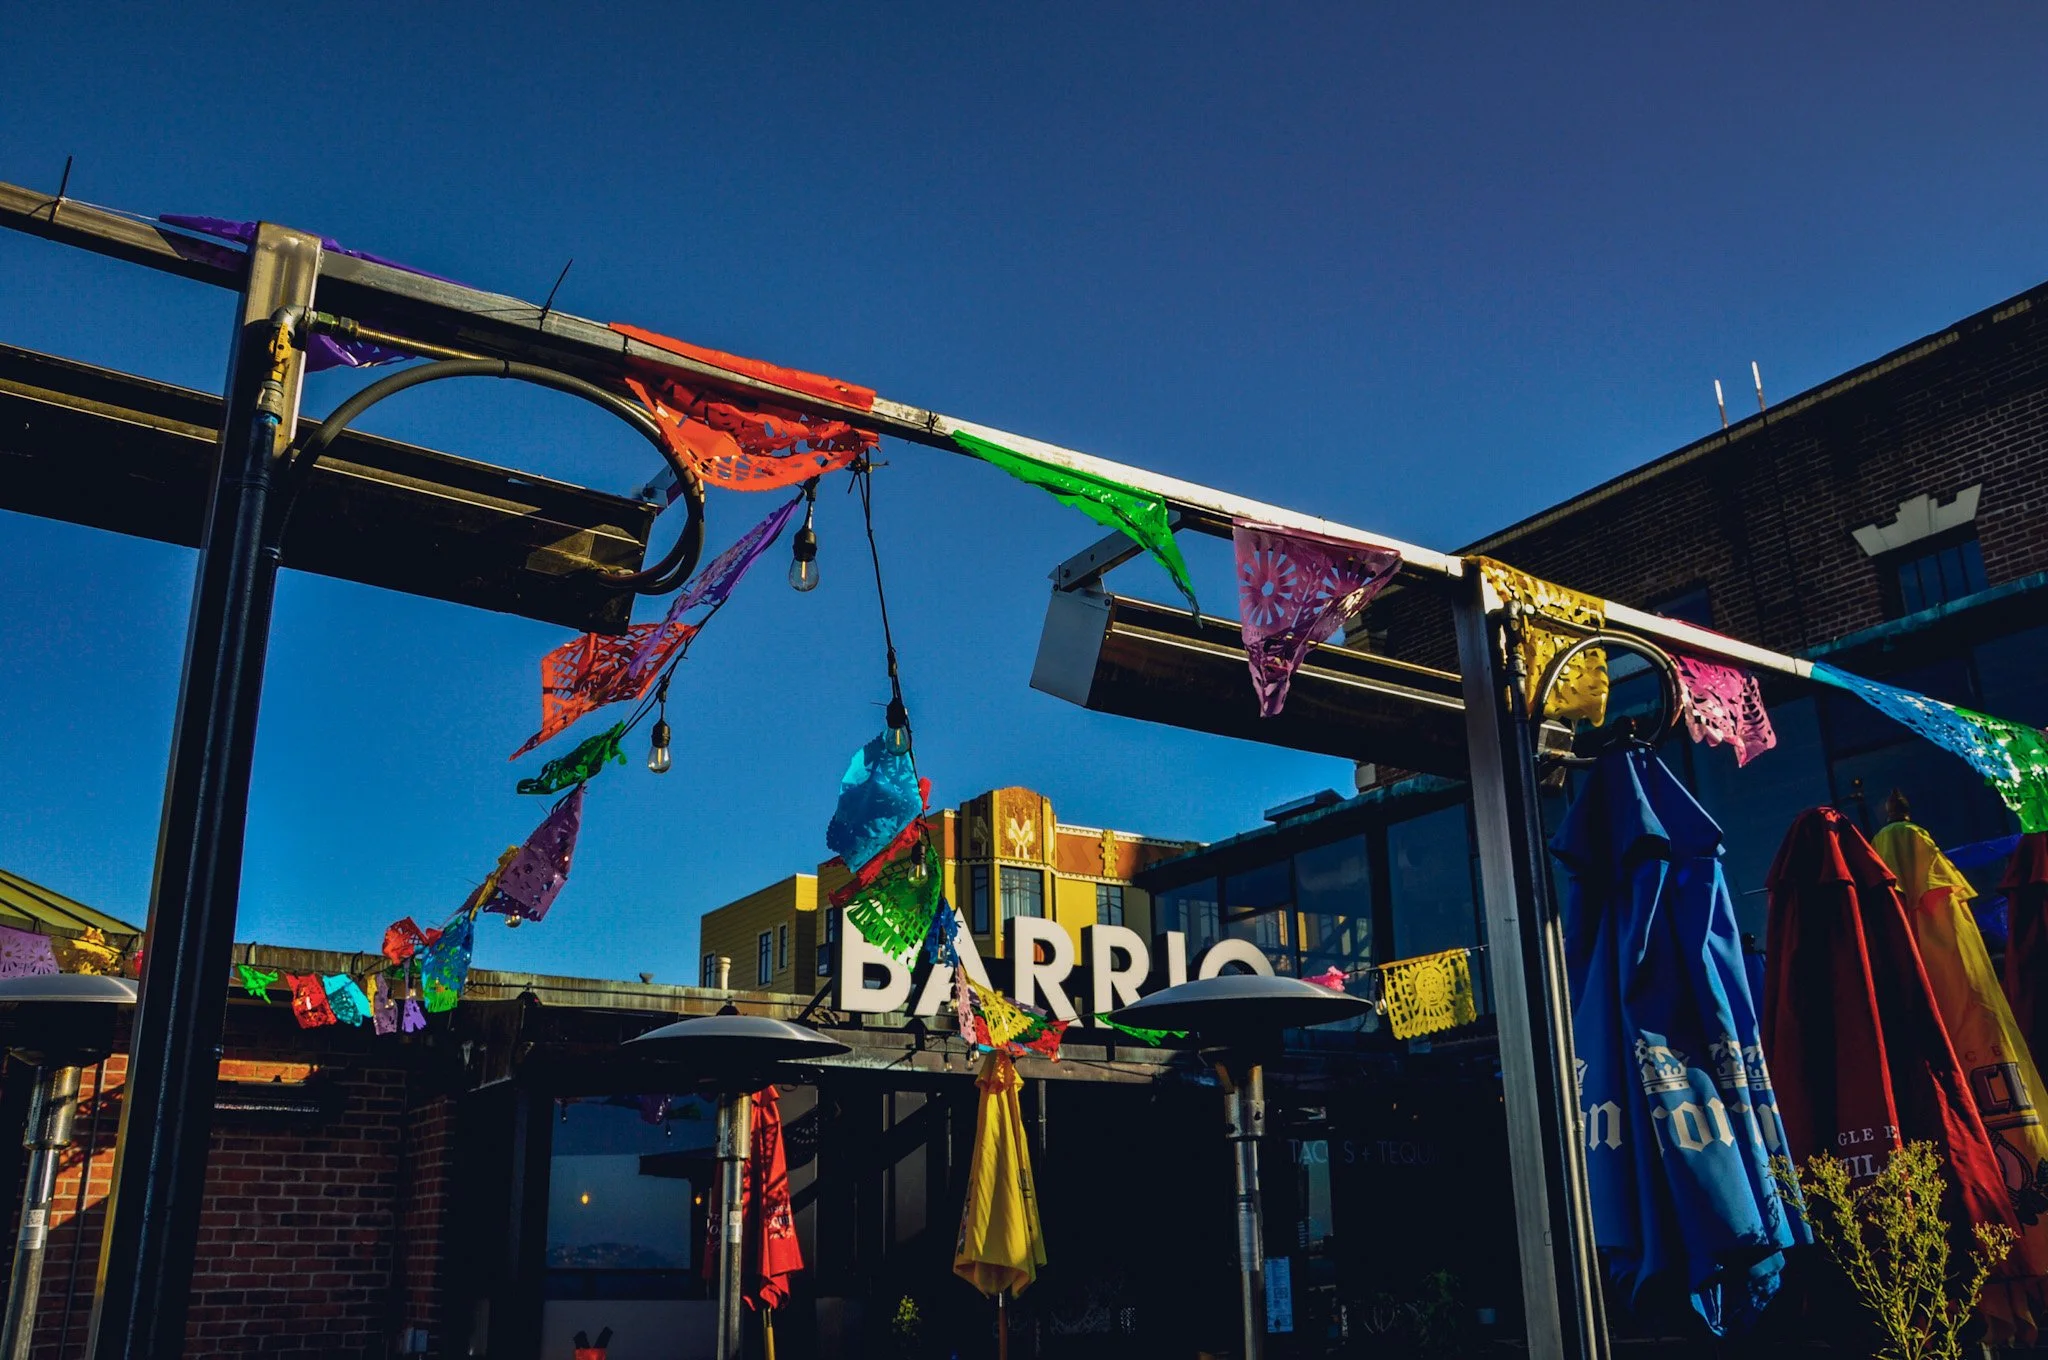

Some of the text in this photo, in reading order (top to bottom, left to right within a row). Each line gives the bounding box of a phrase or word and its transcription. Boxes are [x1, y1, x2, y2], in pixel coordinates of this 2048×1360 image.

[1837, 1127, 1875, 1147] GLE
[1286, 1138, 1355, 1164] TACS
[1376, 1140, 1440, 1165] TEQU
